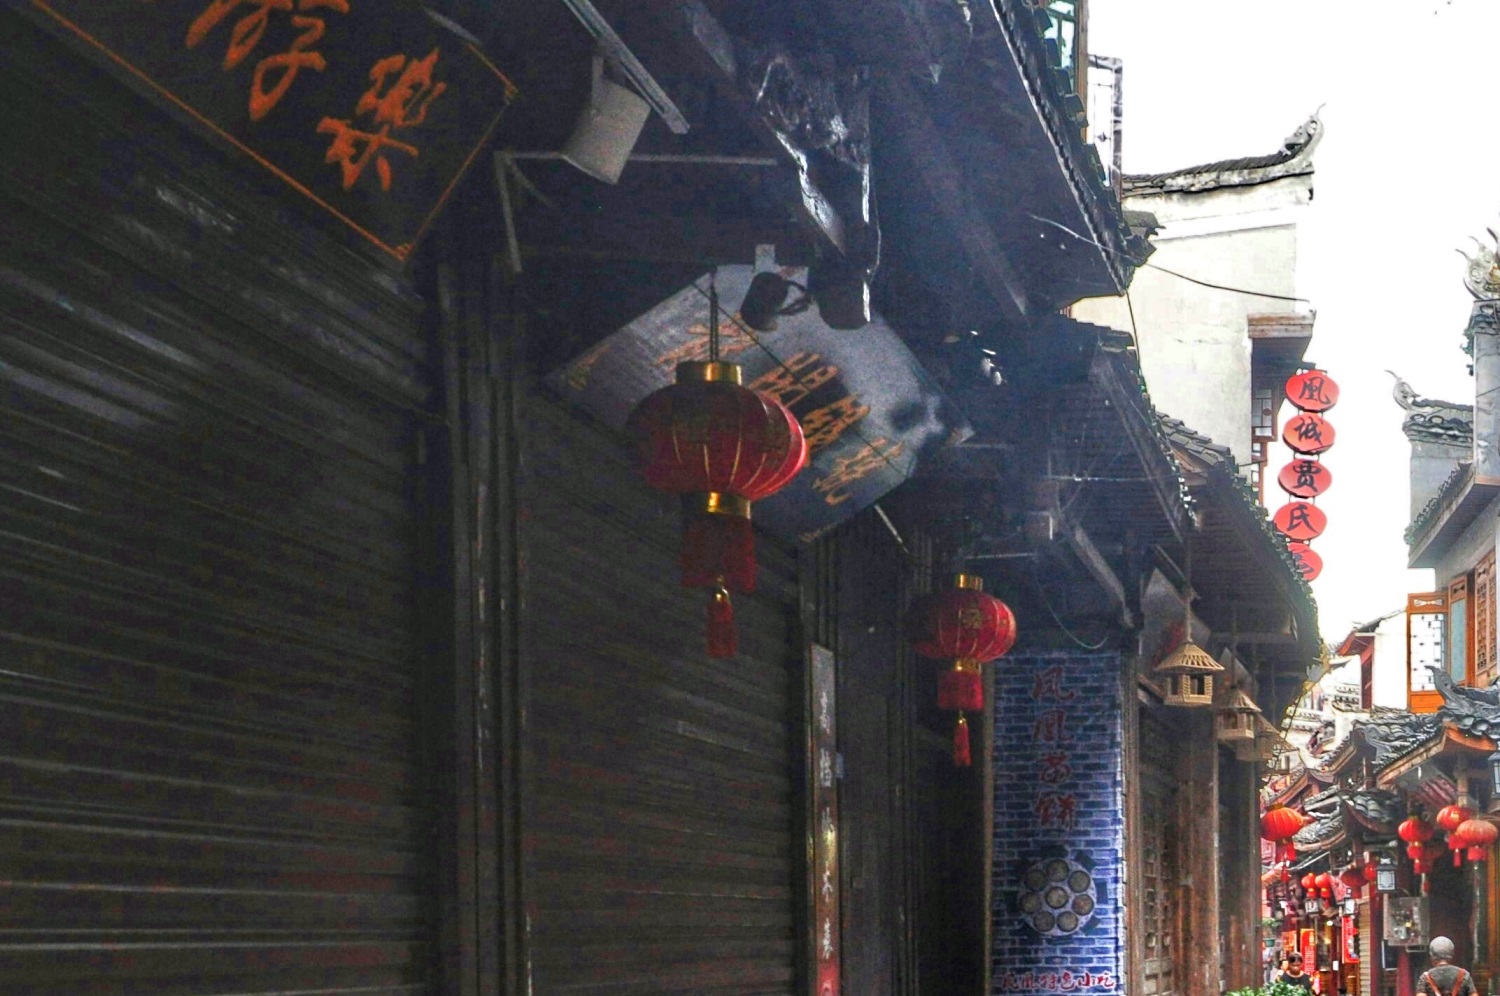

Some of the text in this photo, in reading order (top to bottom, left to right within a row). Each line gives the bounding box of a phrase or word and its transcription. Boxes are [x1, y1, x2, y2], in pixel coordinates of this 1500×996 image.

[1002, 970, 1117, 991] 凤凰特色小吃
